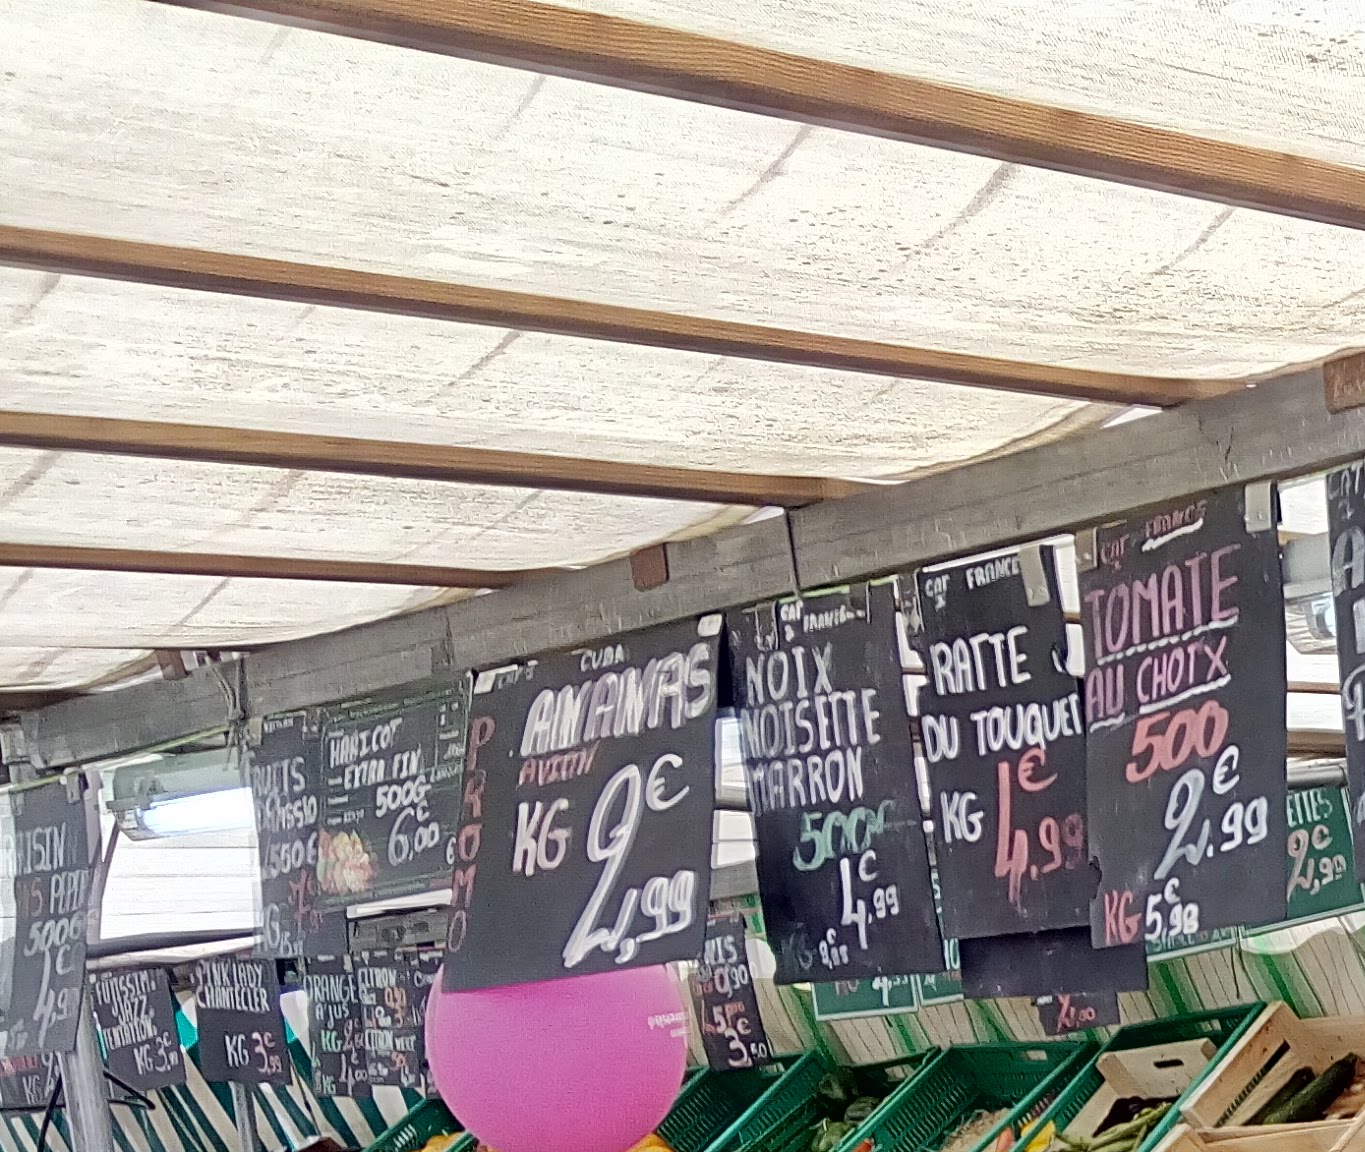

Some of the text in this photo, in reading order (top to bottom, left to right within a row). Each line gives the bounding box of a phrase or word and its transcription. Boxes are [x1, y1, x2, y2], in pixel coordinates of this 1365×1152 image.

[1083, 543, 1242, 657] TOMATE
[745, 641, 833, 706] NOIX
[929, 624, 1033, 697] RATTE
[1085, 663, 1125, 721] AU
[519, 641, 714, 758] ANANAS
[740, 688, 882, 759] NOISETTE
[920, 691, 1084, 764] DU TOUQUET
[328, 717, 404, 769] HARICOT
[1125, 699, 1230, 784] 500
[375, 775, 432, 819] 500G
[750, 746, 865, 813] MARRON
[511, 797, 573, 877] KG
[940, 790, 984, 844] KG
[1103, 889, 1143, 946] KG
[303, 973, 359, 1004] ORANGE
[224, 1033, 250, 1068] KG
